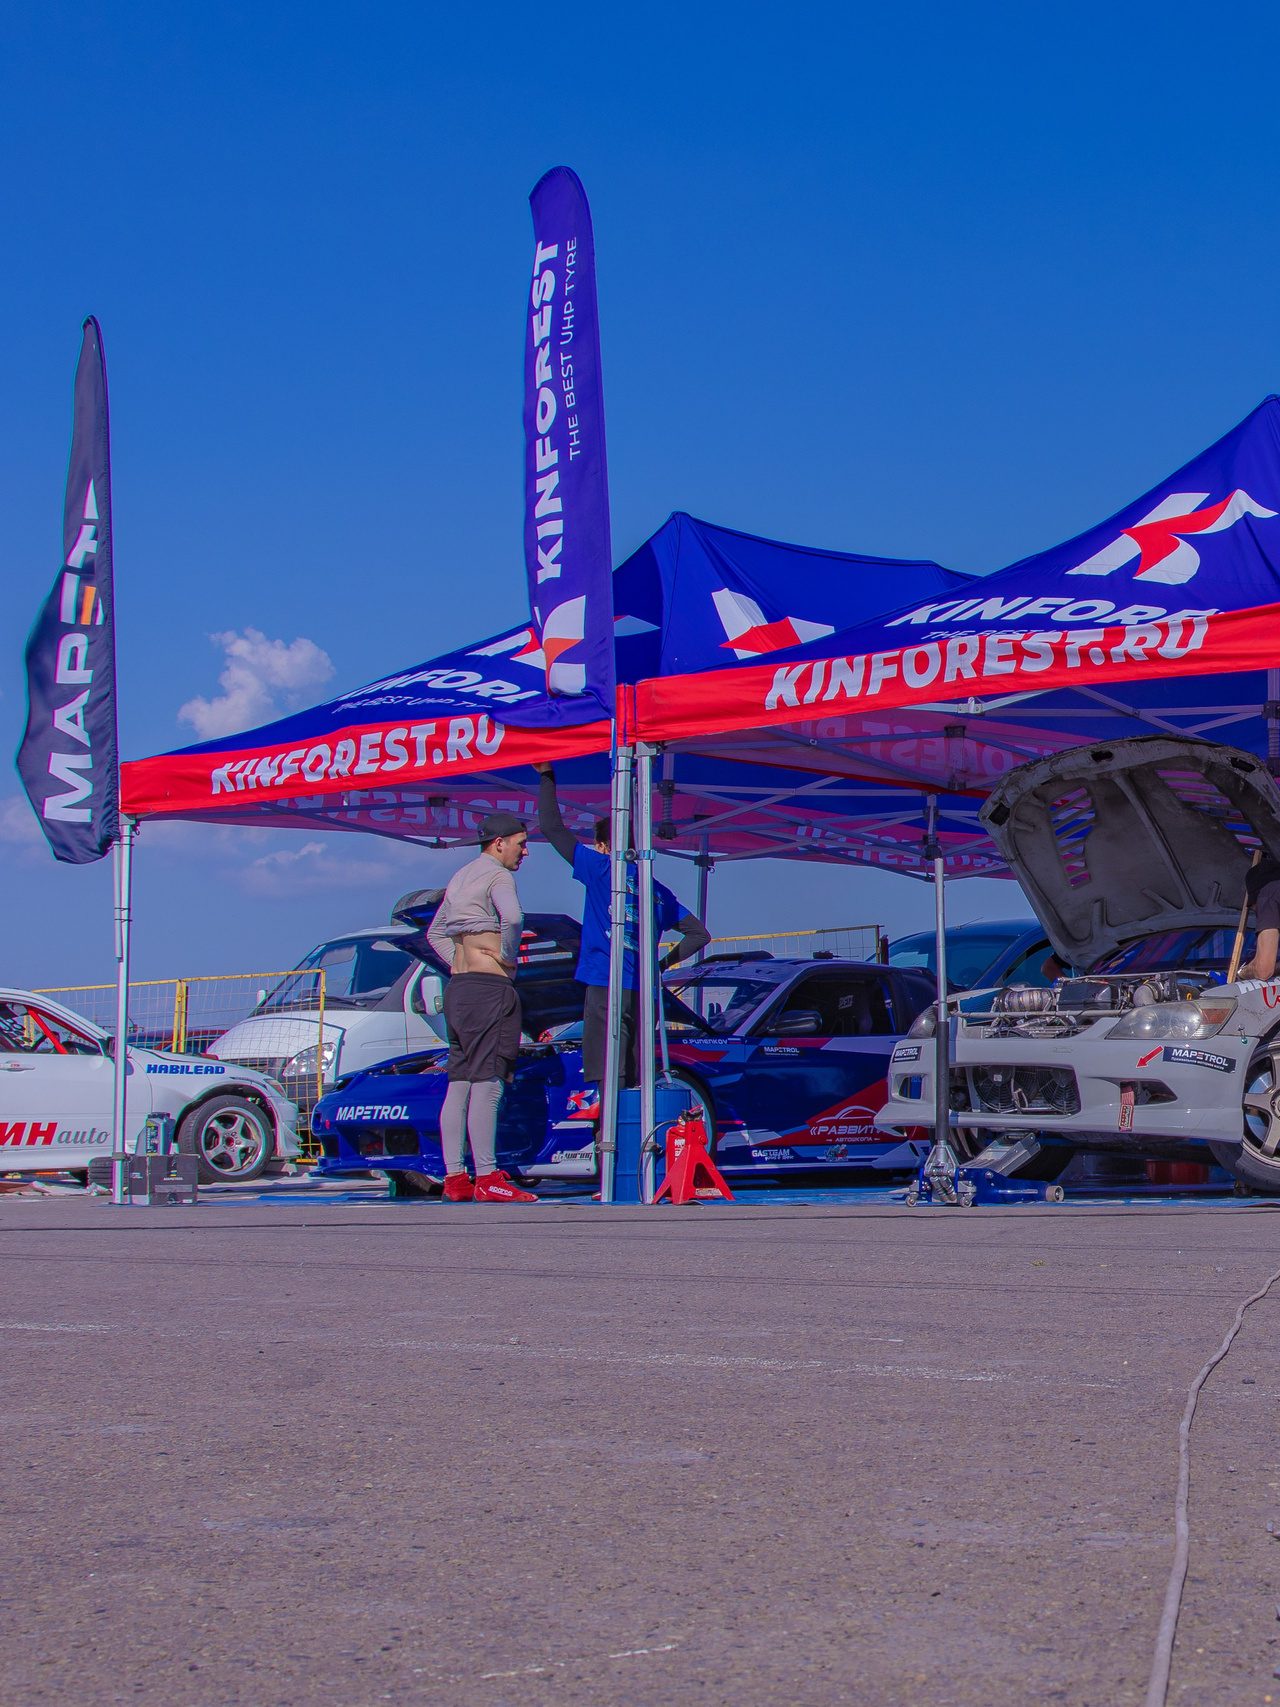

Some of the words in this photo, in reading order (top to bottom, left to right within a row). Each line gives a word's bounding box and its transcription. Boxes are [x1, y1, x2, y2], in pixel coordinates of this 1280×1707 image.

[564, 236, 577, 297] TYRE
[559, 301, 574, 347] UHP
[560, 352, 576, 409] BEST
[533, 240, 564, 584] KINFOREST
[567, 414, 580, 461] THE
[44, 477, 103, 822] MAPET
[765, 614, 1210, 711] KINFOREST.RU
[212, 714, 506, 794] KINFOREST.RU
[146, 1064, 226, 1075] HABILEAD
[764, 1046, 800, 1054] MAPETROL
[1172, 1048, 1228, 1067] MAPETROL
[57, 1127, 111, 1144] auto
[335, 1105, 410, 1121] MAPETROL
